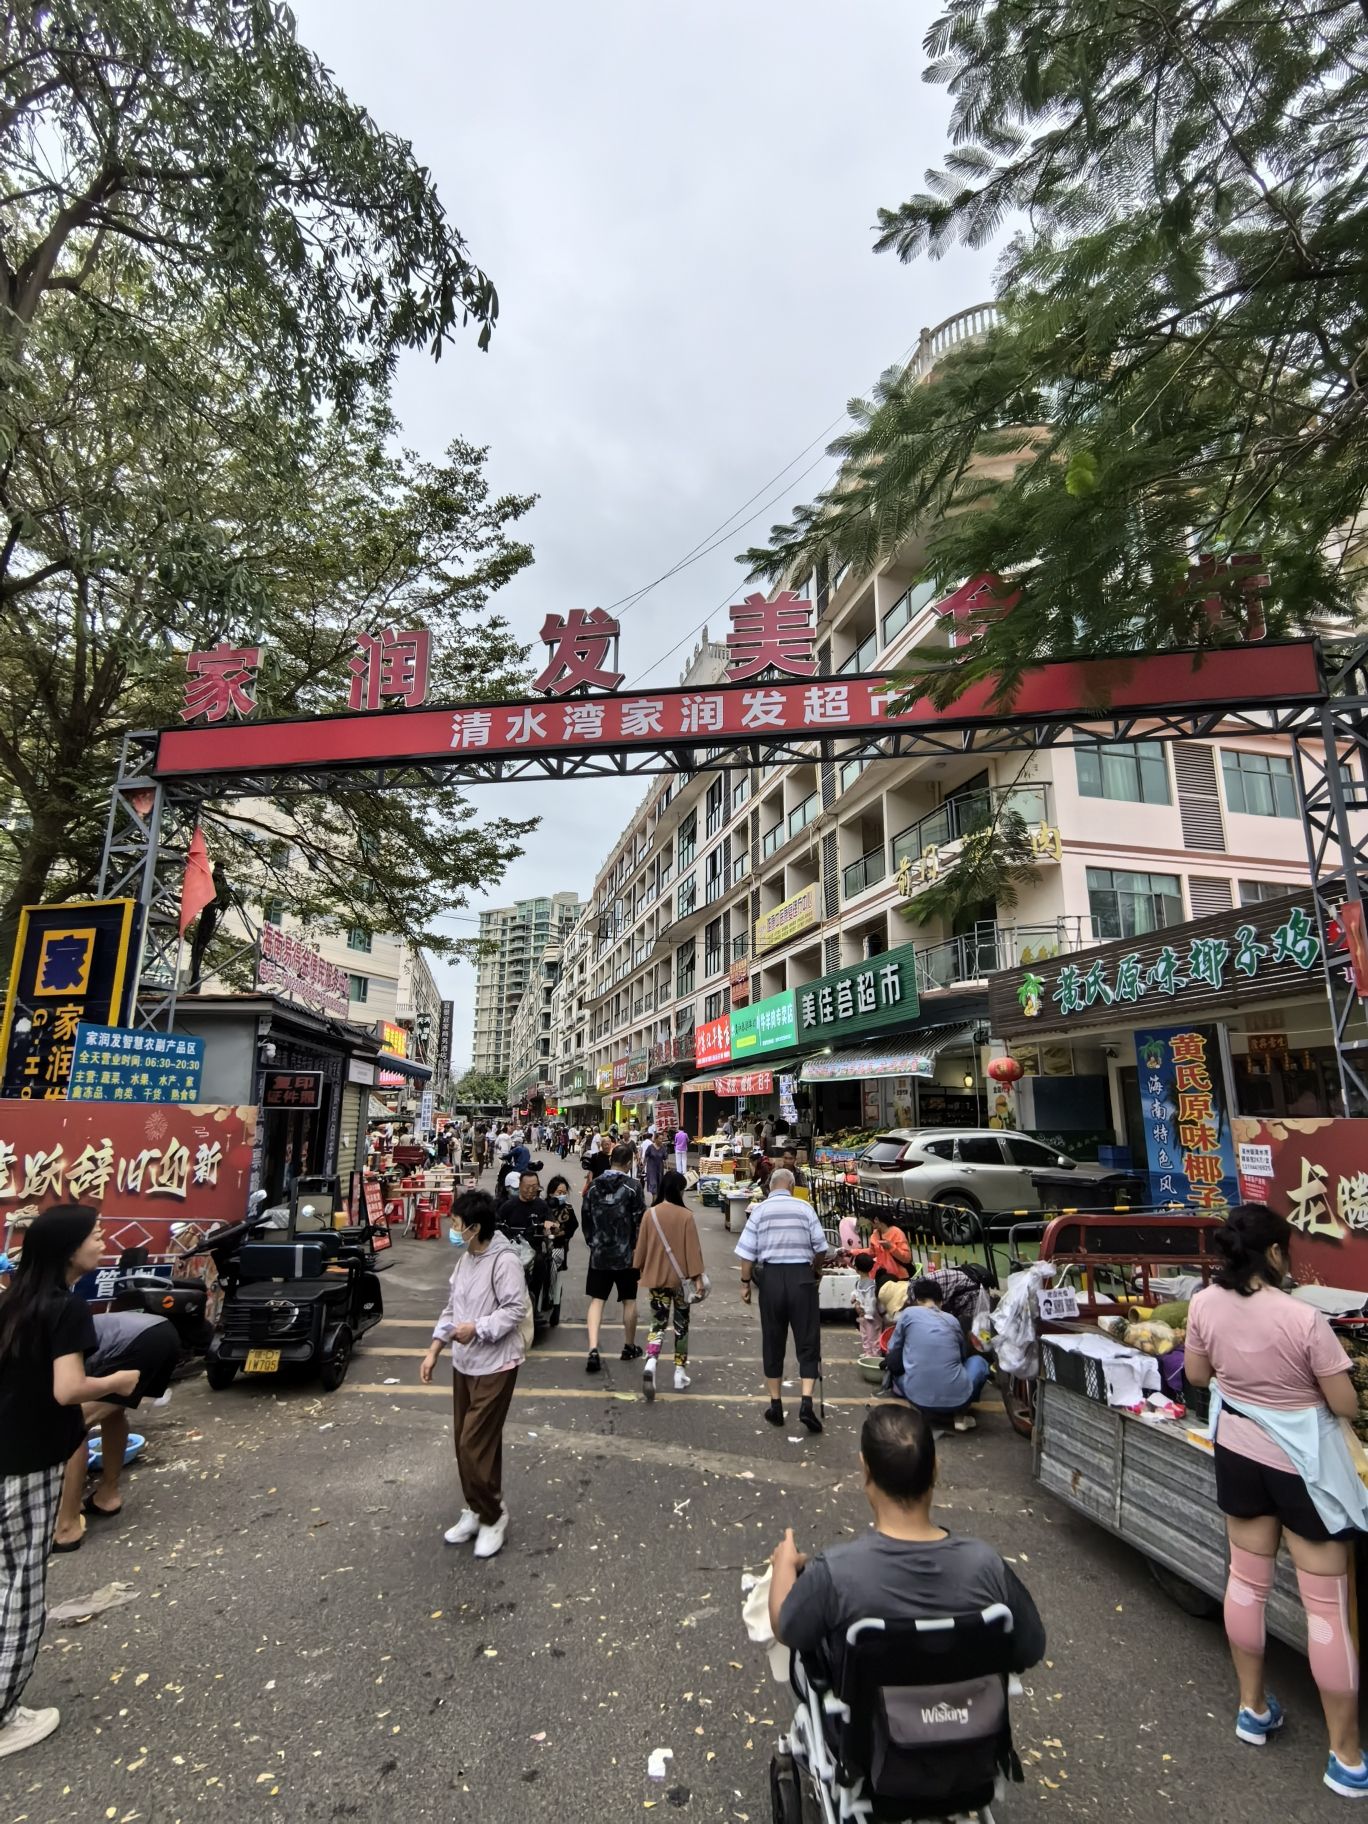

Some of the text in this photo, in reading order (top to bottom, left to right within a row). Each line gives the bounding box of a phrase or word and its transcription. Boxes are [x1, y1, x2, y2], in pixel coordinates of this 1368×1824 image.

[450, 681, 915, 748] 清水湾家润发超市
[1053, 907, 1321, 1015] 黄氏原味椰子鸡
[802, 962, 902, 1029] 美佳荟超市
[86, 1031, 197, 1055] 家润发智慧农副产品区
[921, 1701, 969, 1725] Wisking
